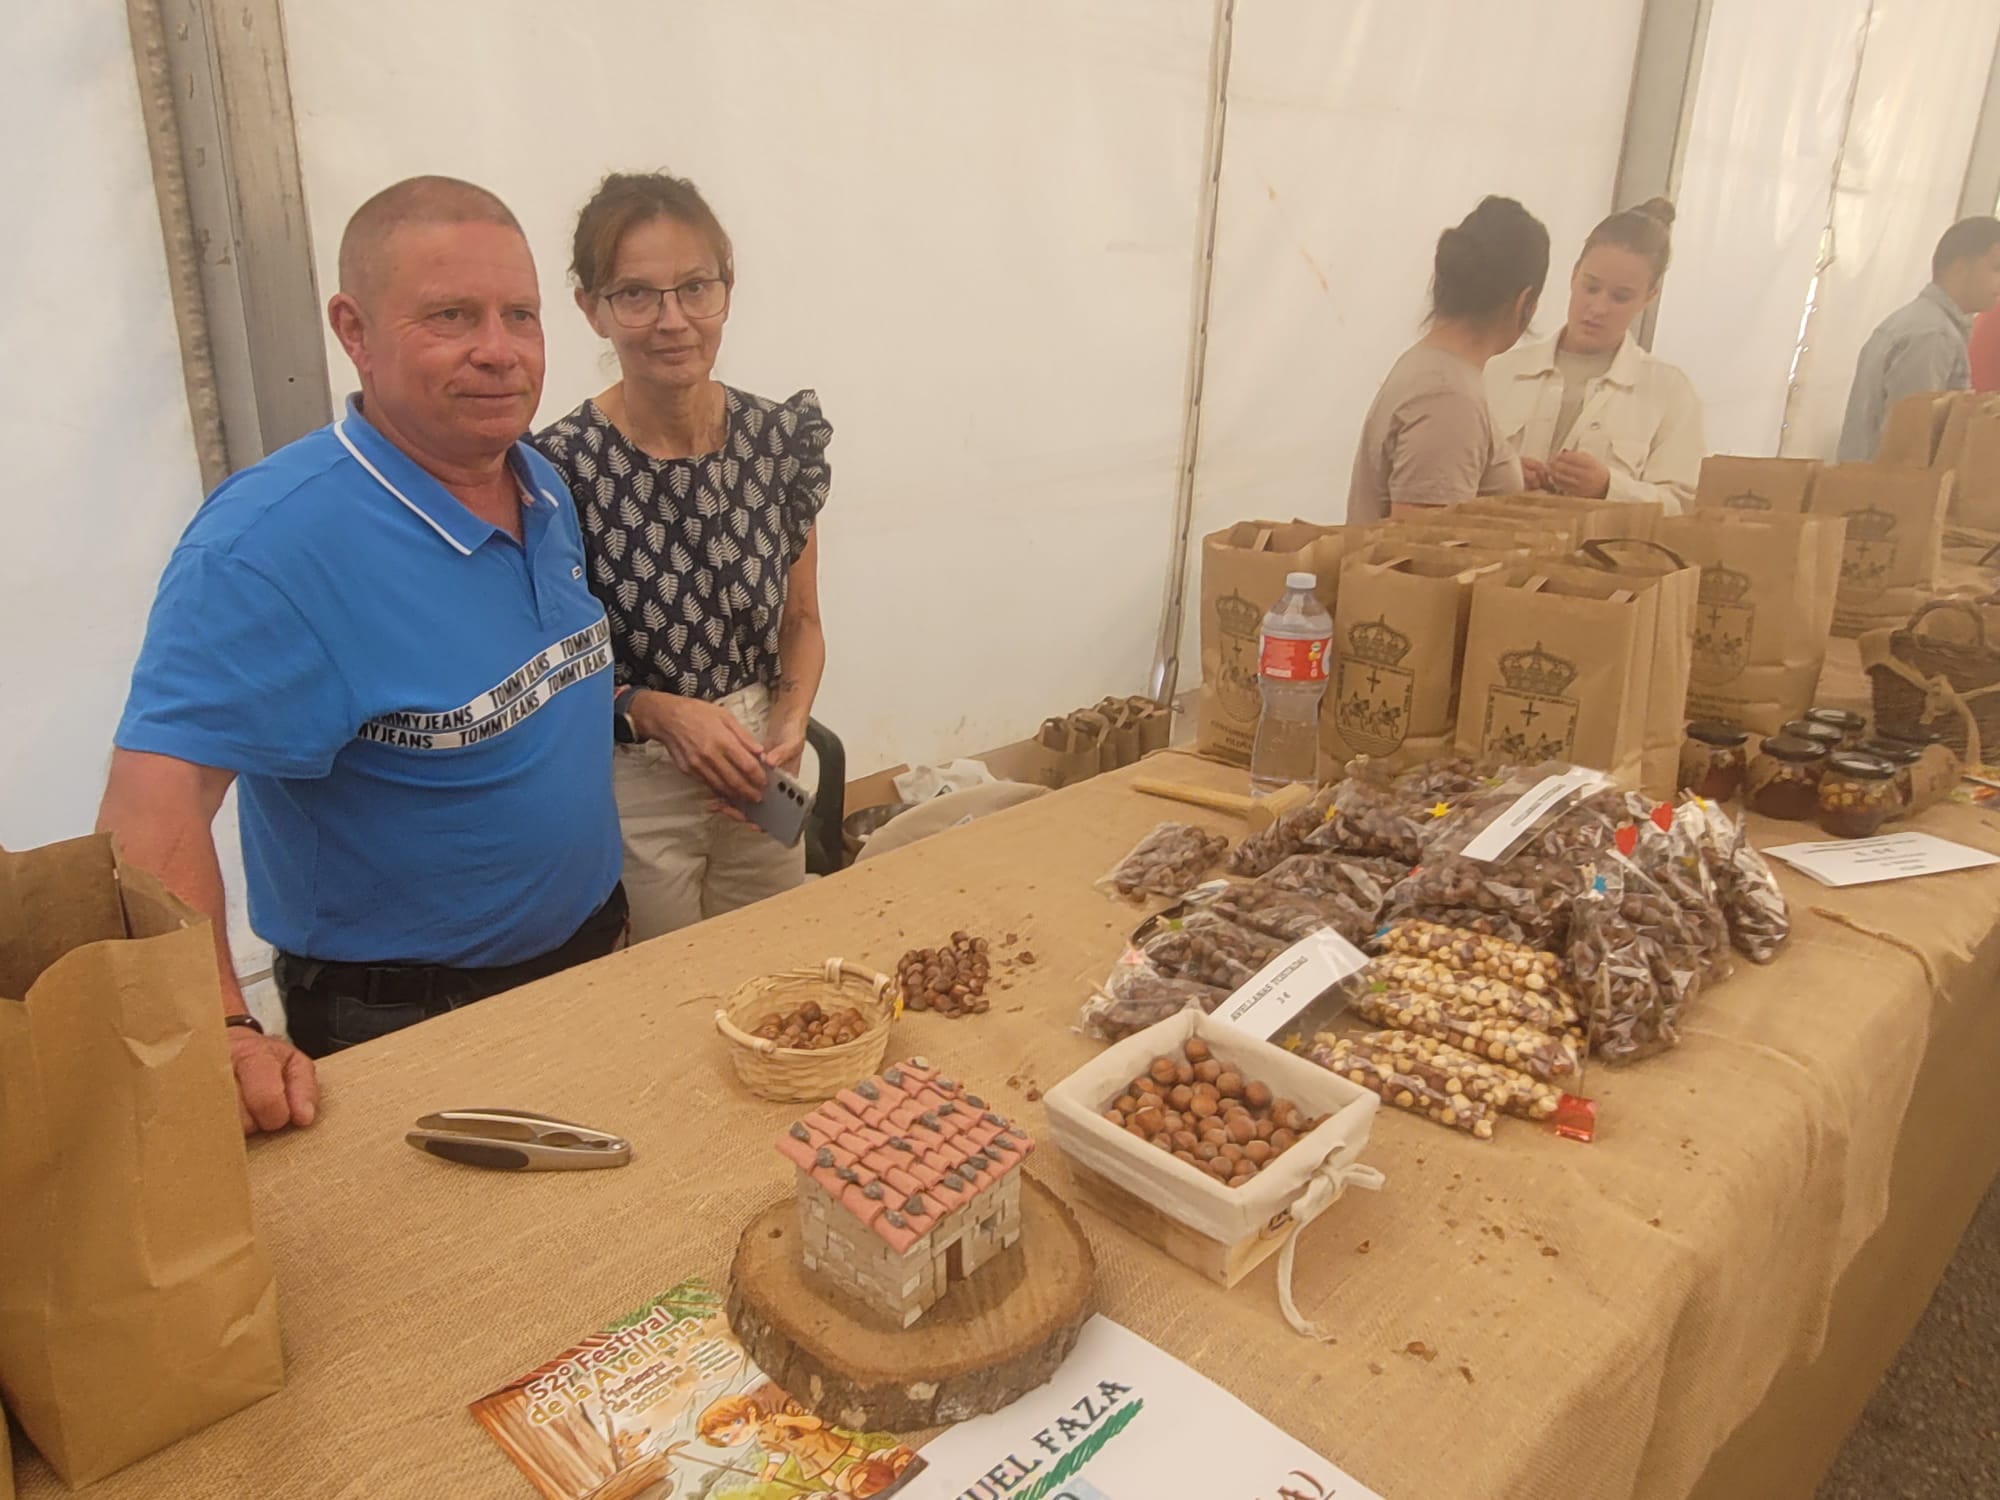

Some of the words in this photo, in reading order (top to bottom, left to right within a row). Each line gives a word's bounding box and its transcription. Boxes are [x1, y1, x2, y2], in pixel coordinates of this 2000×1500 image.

[380, 728, 433, 749] JEANS
[459, 711, 509, 745] TOMMY
[509, 691, 540, 725] JEANS
[547, 660, 582, 695] TOMMY
[582, 648, 607, 676] JEANS
[424, 705, 474, 730] JEANS
[488, 673, 528, 708] TOMMY
[560, 628, 597, 659] TOMMY
[1230, 983, 1273, 1022] AVELLANAS
[531, 1400, 566, 1424] de
[560, 1383, 594, 1405] la
[594, 1318, 700, 1388] Avellana
[575, 1307, 671, 1373] Festival
[630, 1365, 685, 1400] octubre
[1031, 1380, 1133, 1455] FAZA
